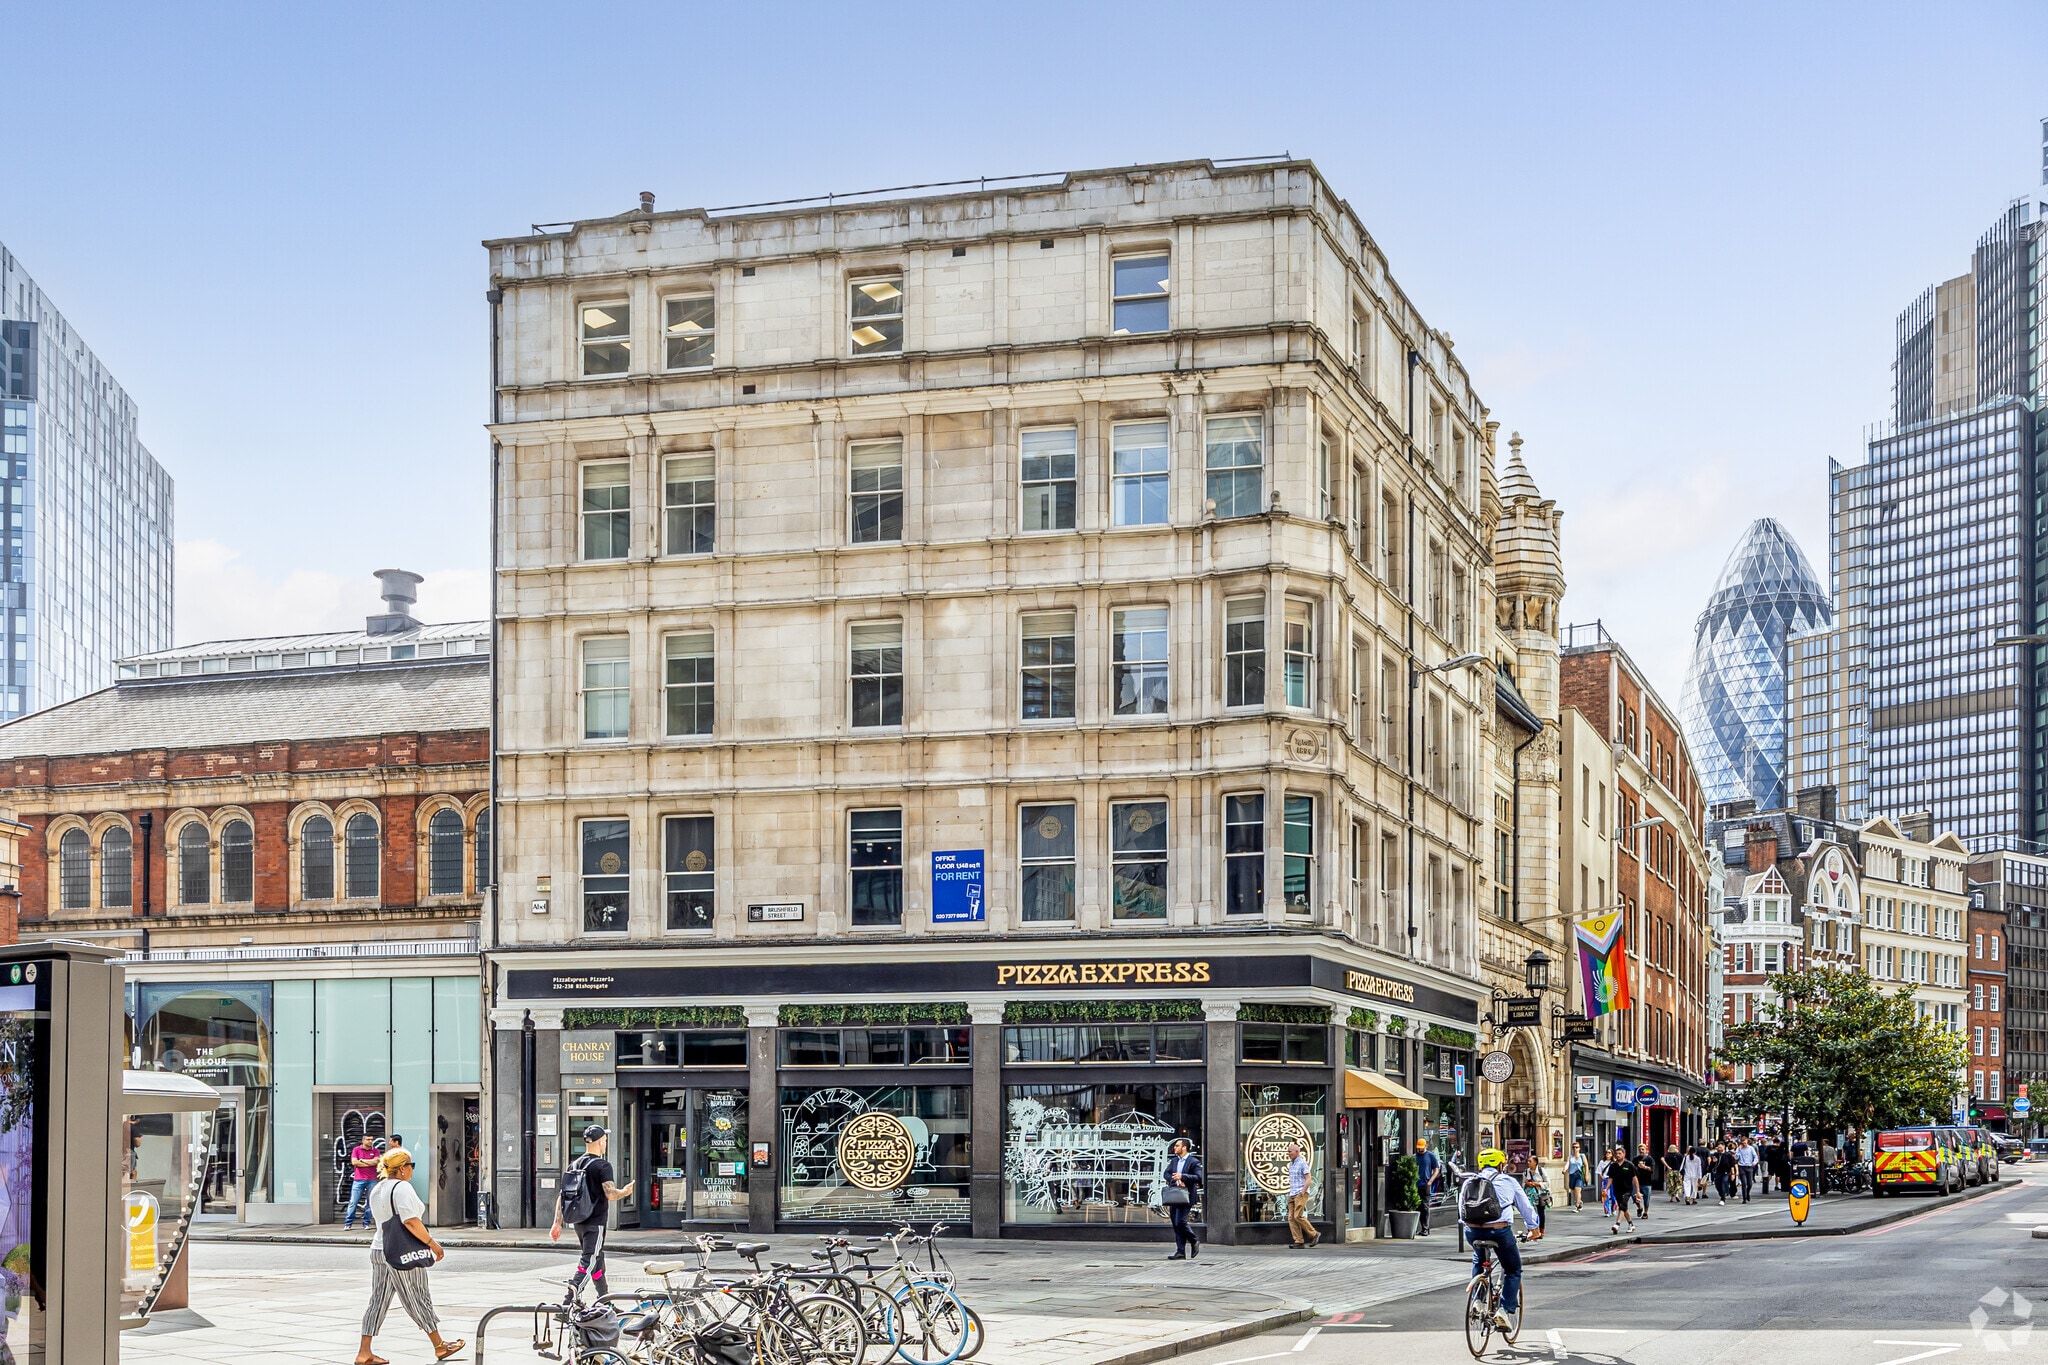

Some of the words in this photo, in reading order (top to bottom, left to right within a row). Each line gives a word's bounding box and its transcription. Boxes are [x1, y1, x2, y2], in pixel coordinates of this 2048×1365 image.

[935, 872, 955, 881] FOR
[955, 871, 981, 880] RENT
[997, 962, 1211, 985] PIZZAEXPRESS
[1346, 970, 1414, 1003] PIZZAEXPRESS
[562, 1042, 612, 1051] CHANRAY
[196, 1048, 214, 1056] THE
[570, 1052, 605, 1062] HOUSE
[183, 1058, 227, 1066] PARLOUR
[802, 1088, 866, 1115] PIZZA
[857, 1140, 895, 1150] PIZZA
[847, 1150, 906, 1160] EXPRESS
